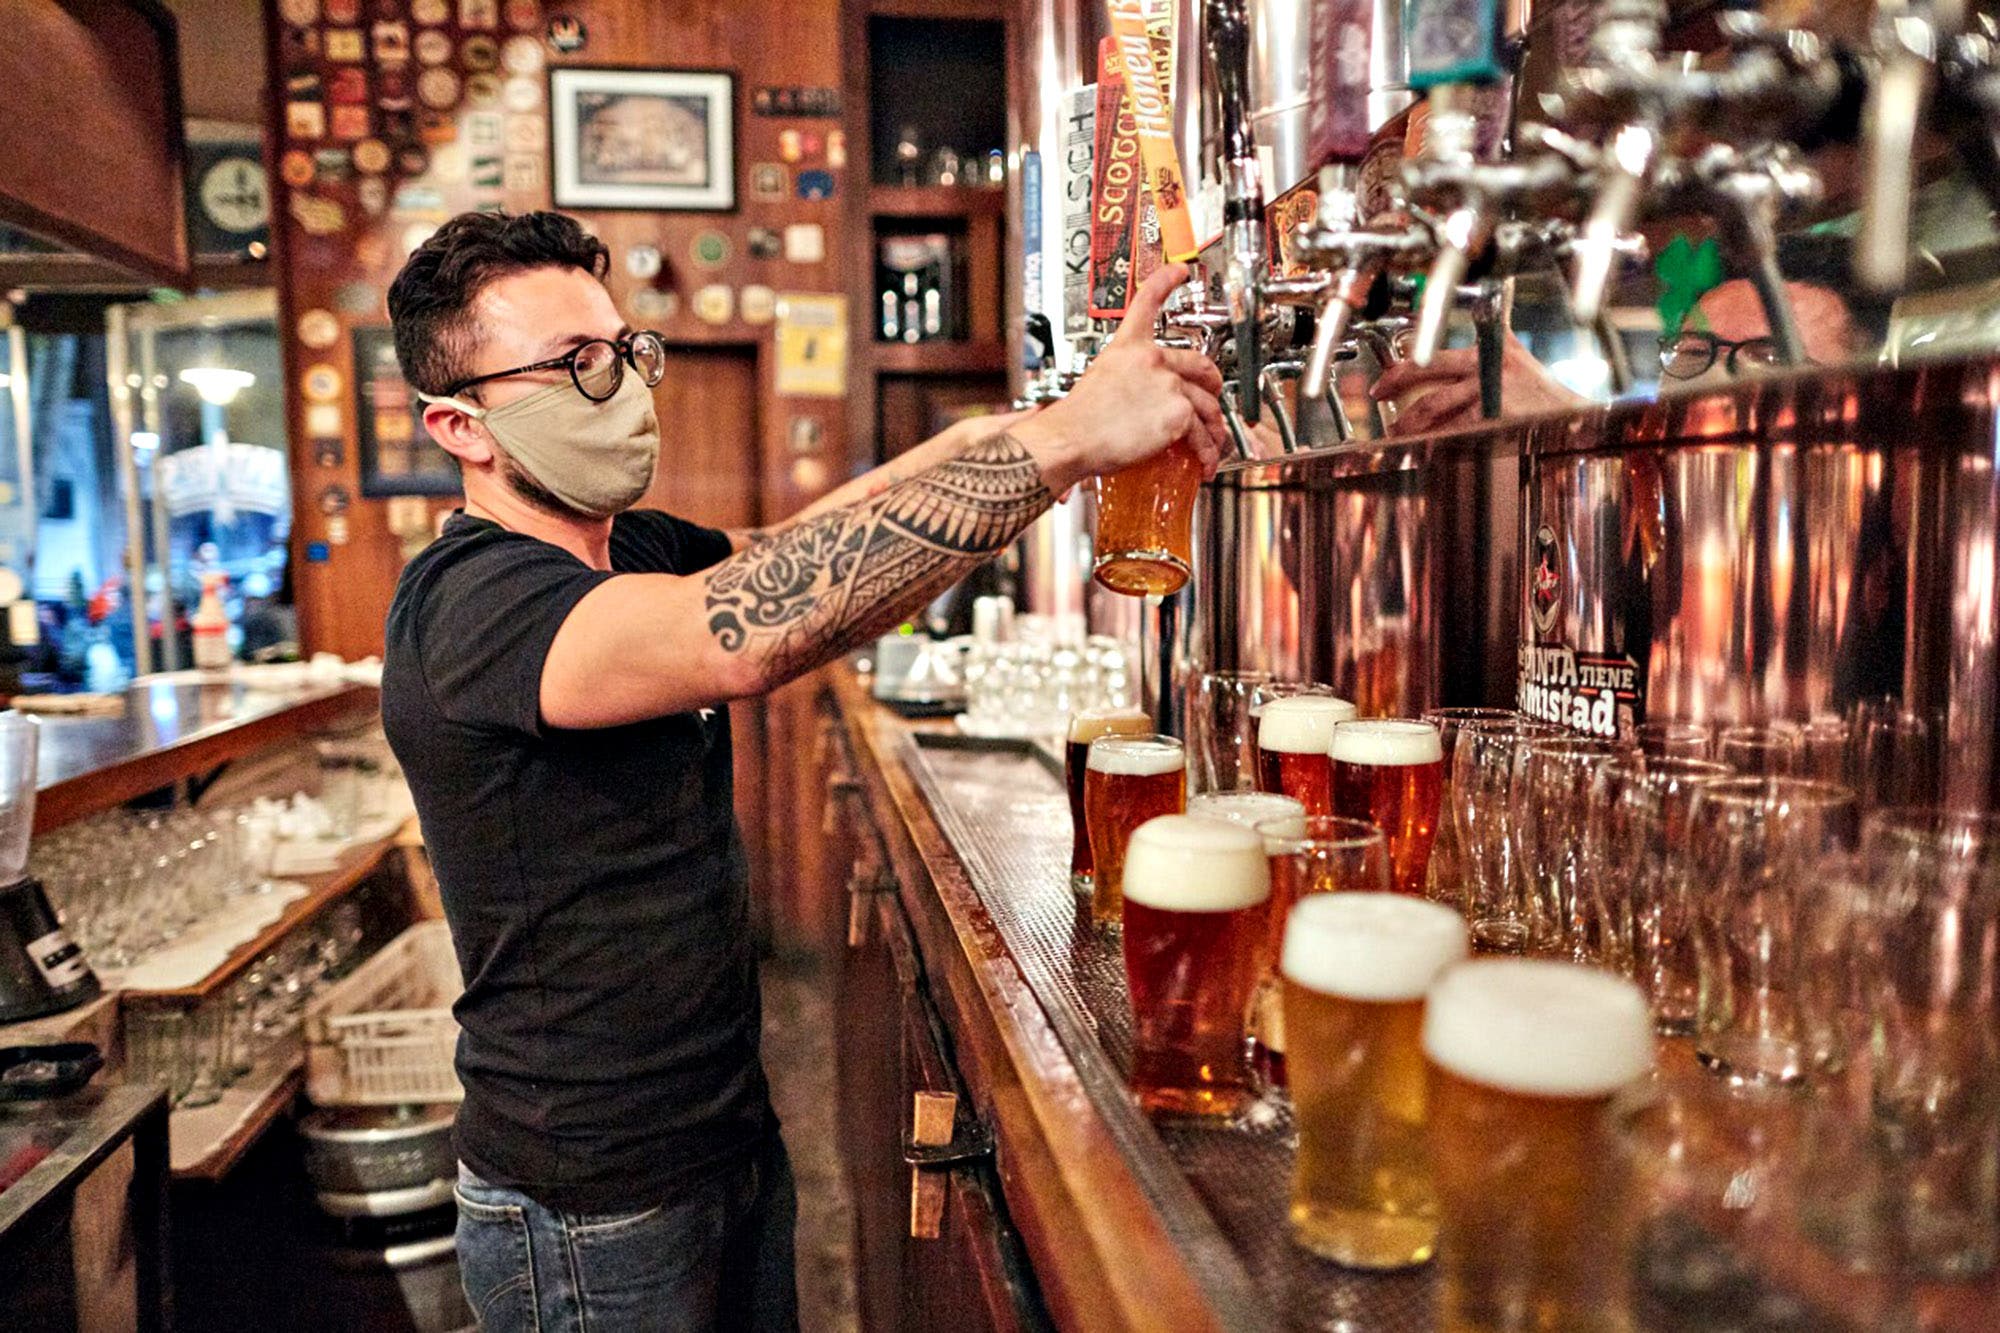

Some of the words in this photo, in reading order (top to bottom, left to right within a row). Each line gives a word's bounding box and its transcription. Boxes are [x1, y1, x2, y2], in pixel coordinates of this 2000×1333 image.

[1118, 34, 1170, 138] Honey
[1064, 112, 1095, 288] KÖLSCH
[1580, 665, 1634, 690] TIENE
